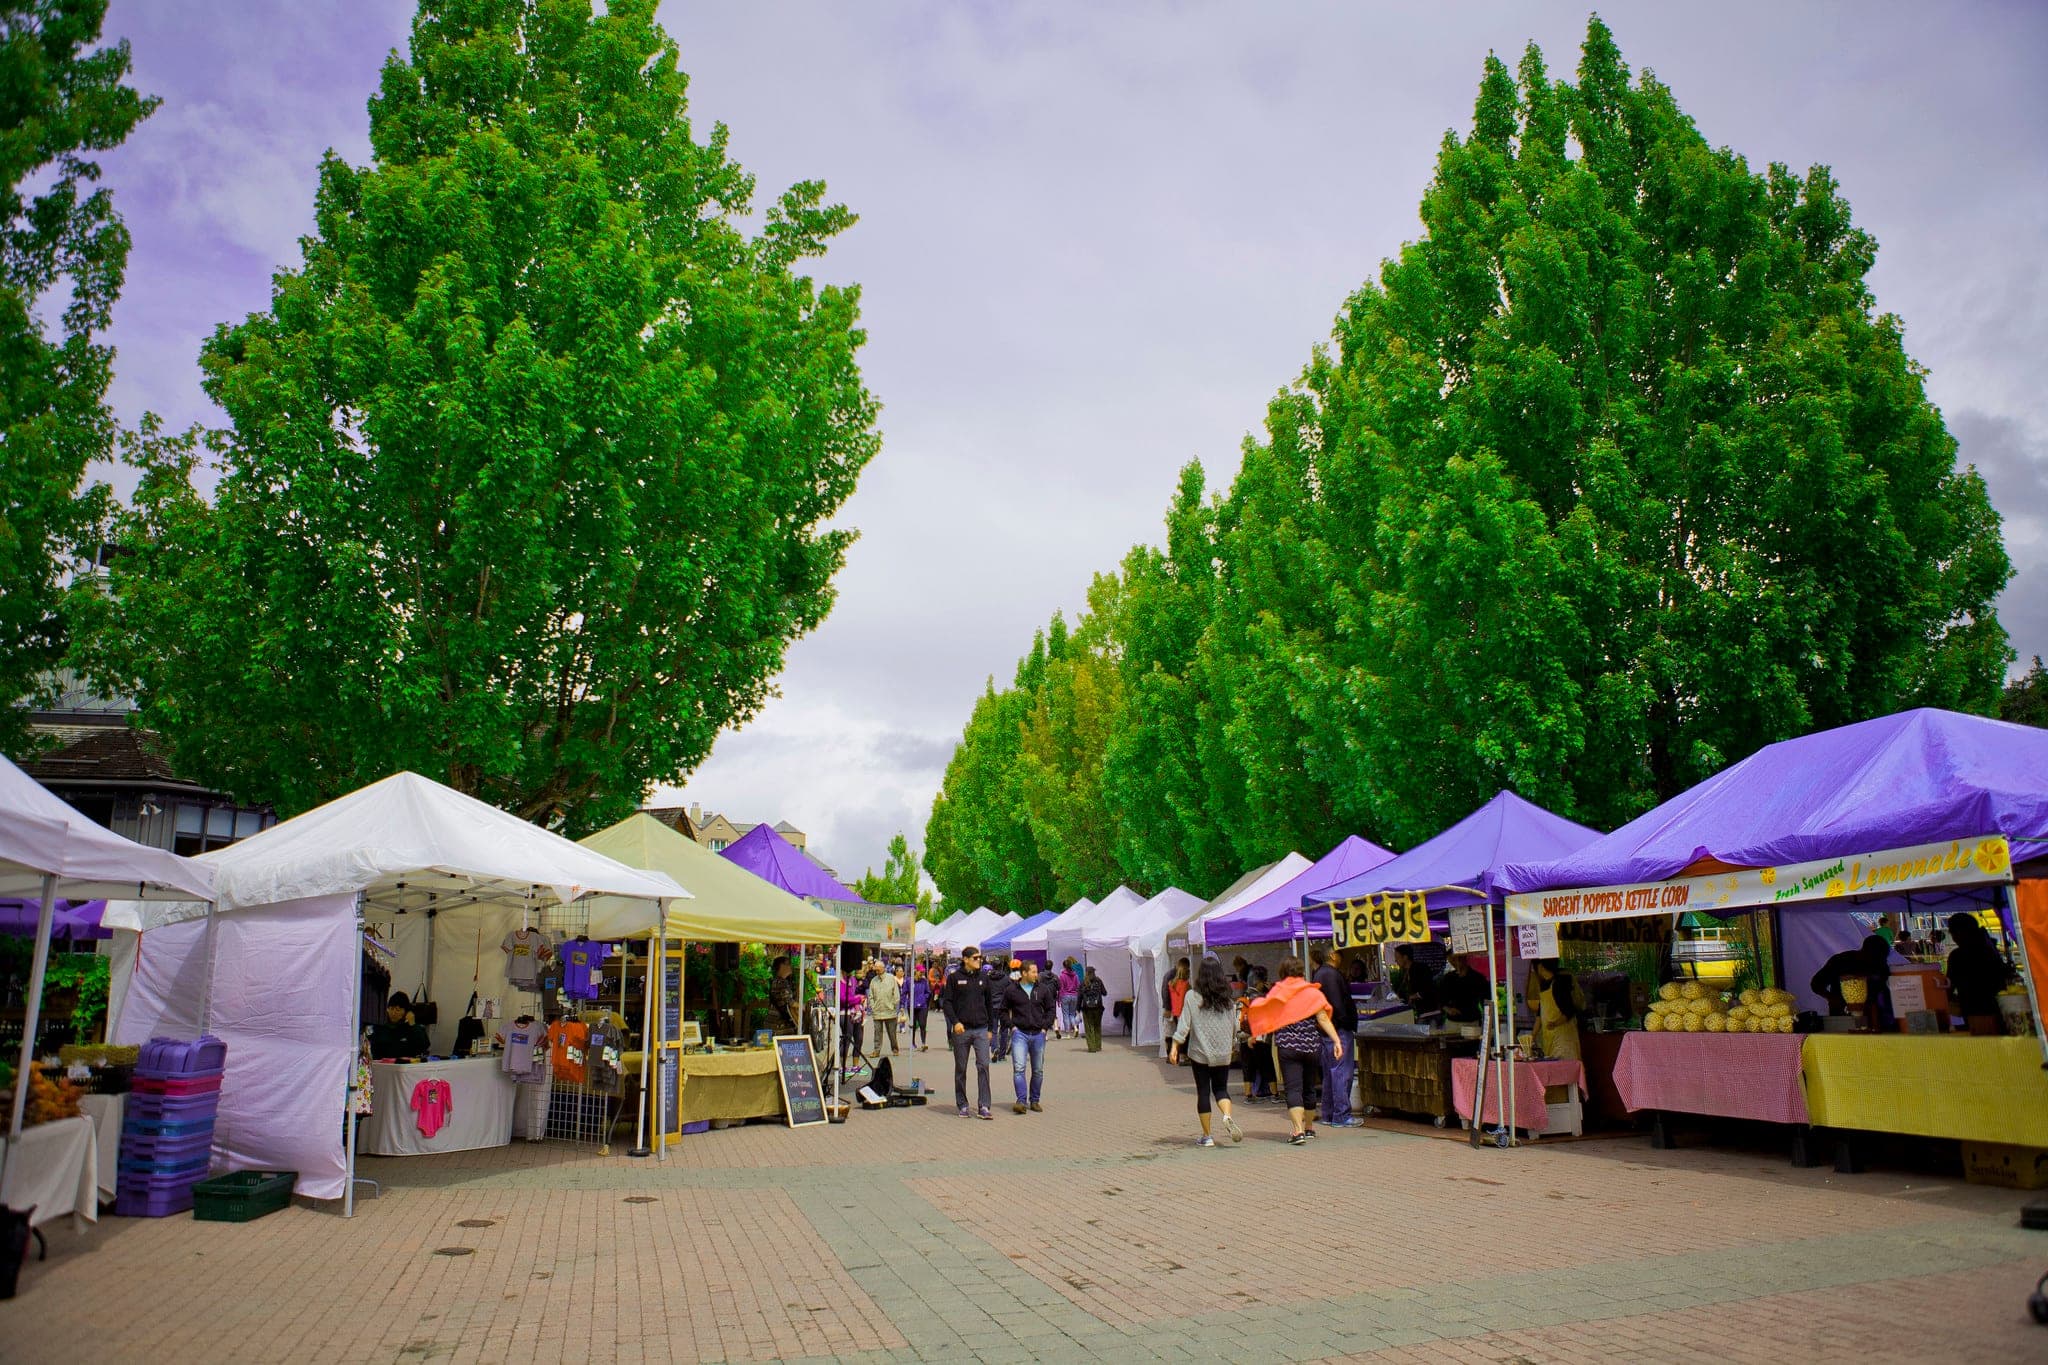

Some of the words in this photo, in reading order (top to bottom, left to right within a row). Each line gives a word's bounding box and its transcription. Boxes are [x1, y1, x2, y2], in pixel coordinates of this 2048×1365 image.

[1775, 883, 1800, 902] Fresh
[1801, 859, 1845, 891] Squeezed
[1848, 841, 1972, 891] Lemonade
[1542, 895, 1581, 918] SARGENT
[1583, 891, 1623, 914] POPPERS
[1625, 888, 1660, 911] KETTLE
[1661, 884, 1690, 908] CORN
